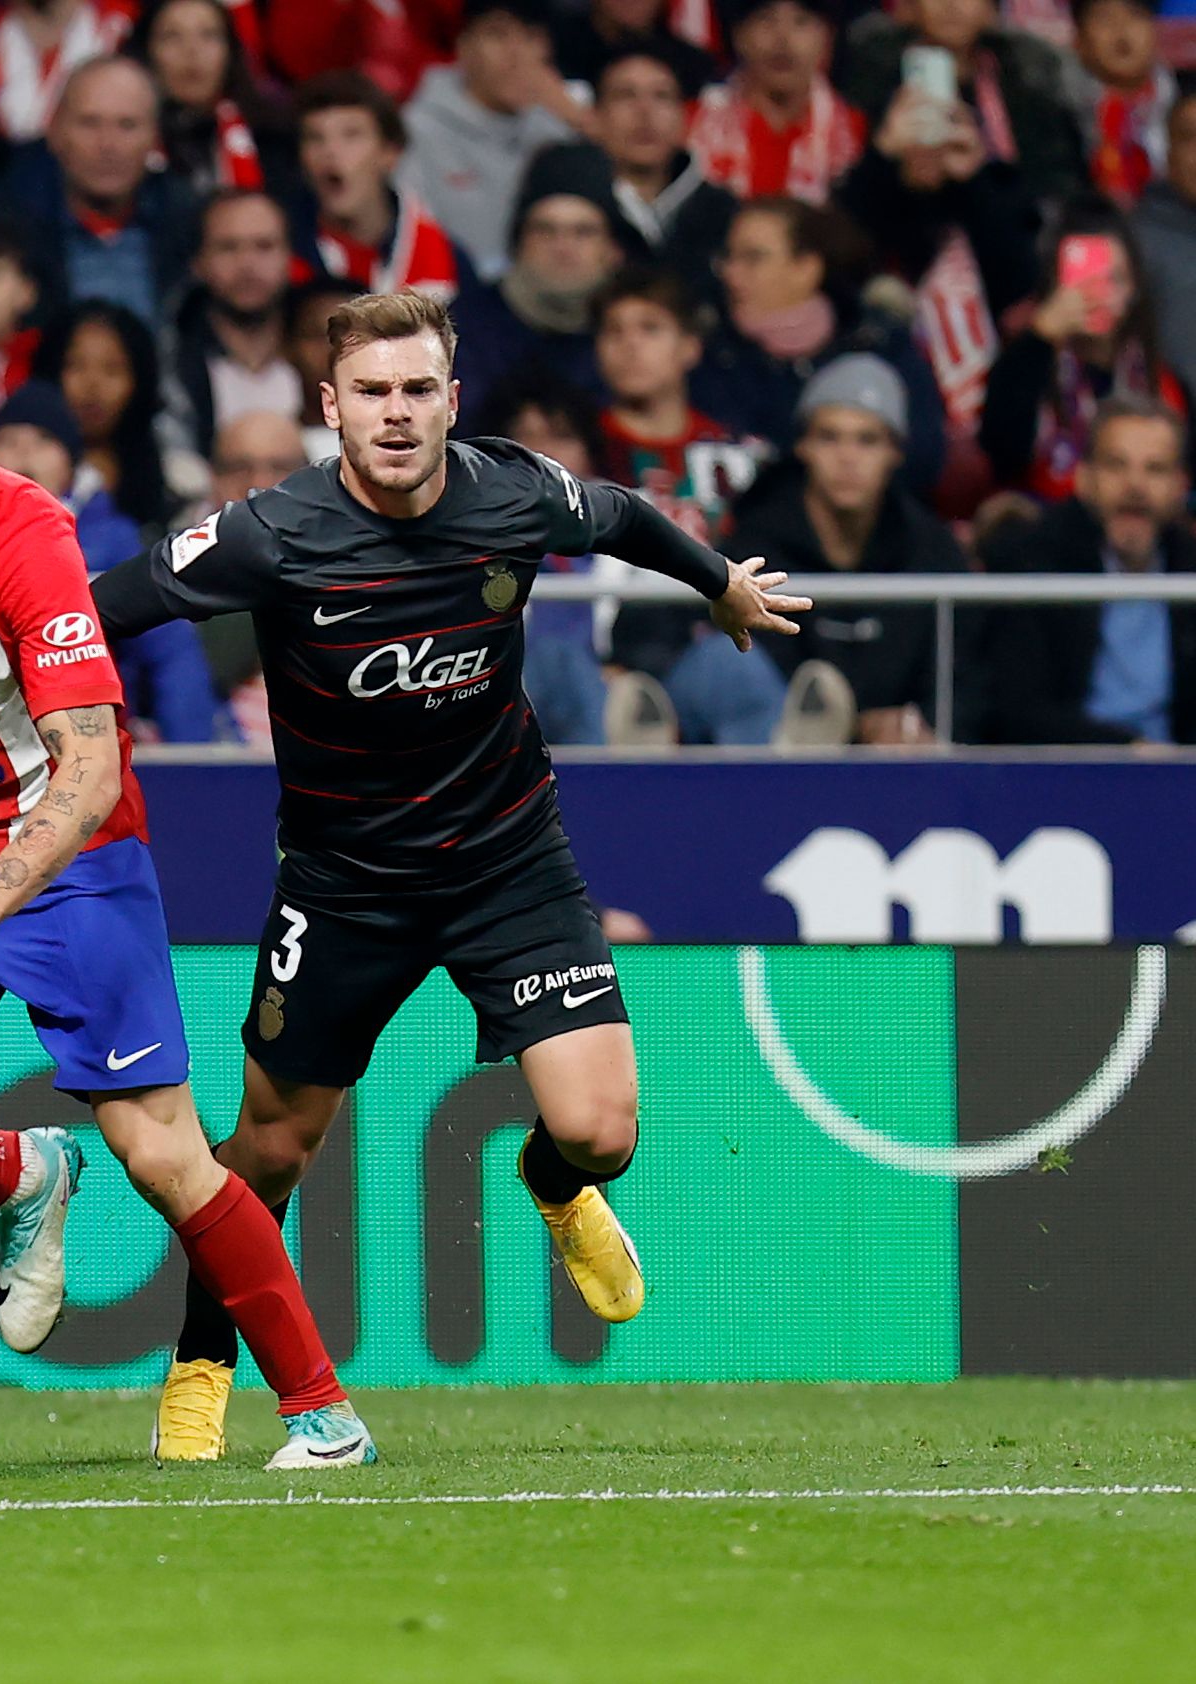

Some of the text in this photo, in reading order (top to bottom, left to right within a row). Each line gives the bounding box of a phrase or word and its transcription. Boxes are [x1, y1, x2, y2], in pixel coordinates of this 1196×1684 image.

[36, 643, 109, 669] HYUNDA
[424, 679, 491, 710] by Taica
[270, 903, 309, 983] 3
[544, 963, 616, 992] AirEurop
